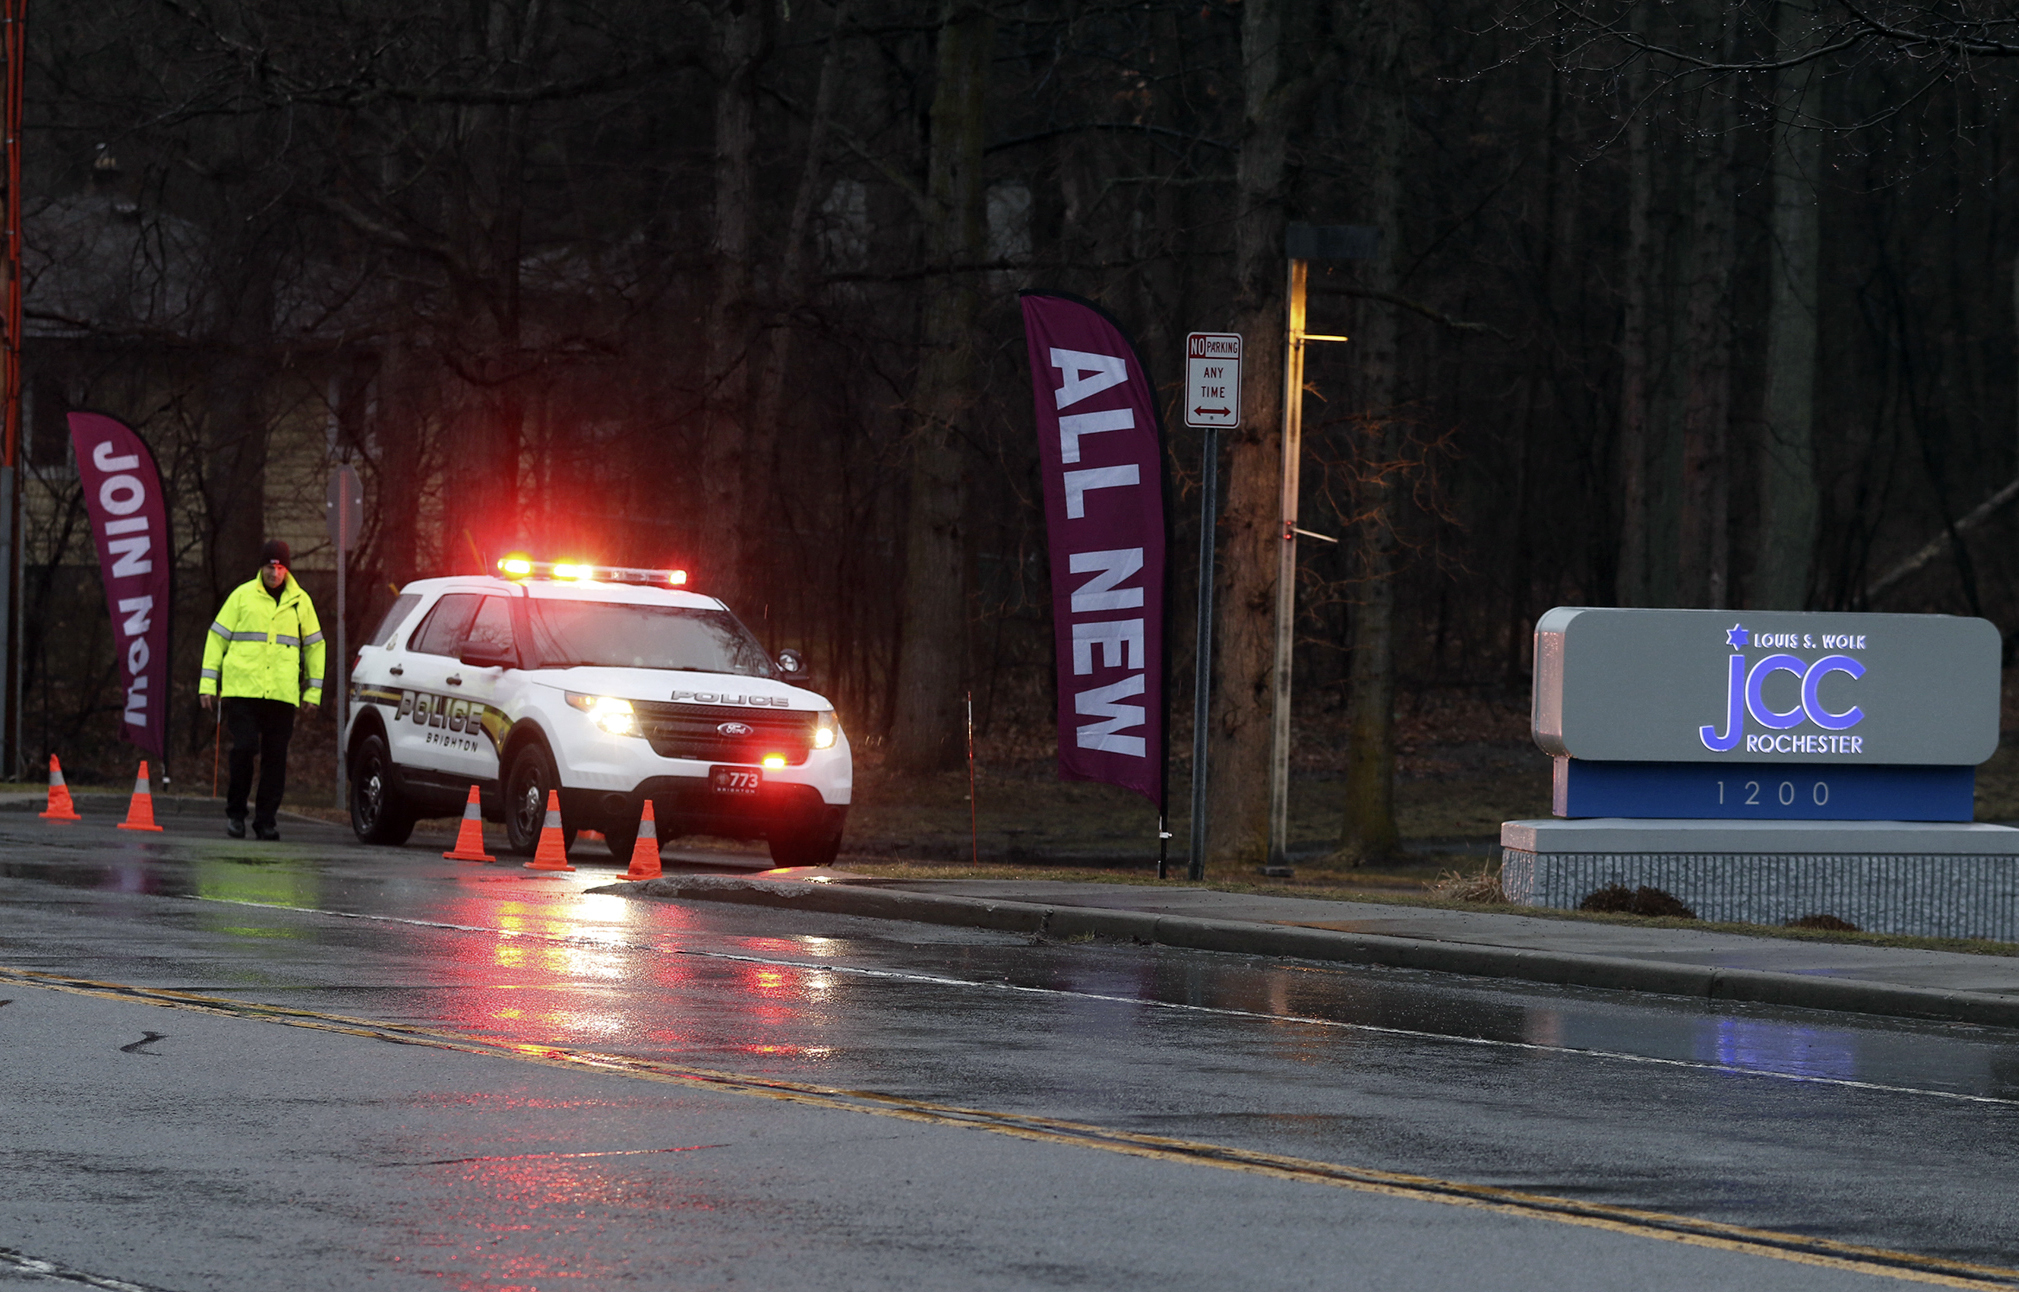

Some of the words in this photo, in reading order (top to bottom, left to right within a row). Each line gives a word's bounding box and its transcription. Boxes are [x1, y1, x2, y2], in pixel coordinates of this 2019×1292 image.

[1190, 338, 1206, 356] NO
[1206, 341, 1238, 354] PARKING
[1203, 366, 1224, 379] ANY
[1201, 385, 1225, 398] TIME
[1049, 346, 1140, 520] ALL
[93, 441, 152, 578] JOIN
[1754, 633, 1799, 649] LOUIS
[1802, 633, 1818, 649] S.
[1822, 634, 1867, 650] WOLK
[1069, 547, 1146, 758] NEW
[671, 690, 789, 708] POLICE
[394, 690, 486, 736] POLICE
[725, 724, 747, 735] Ford
[426, 732, 479, 752] BRIGHTON
[1746, 734, 1864, 754] ROCHESTER
[730, 772, 759, 788] 773
